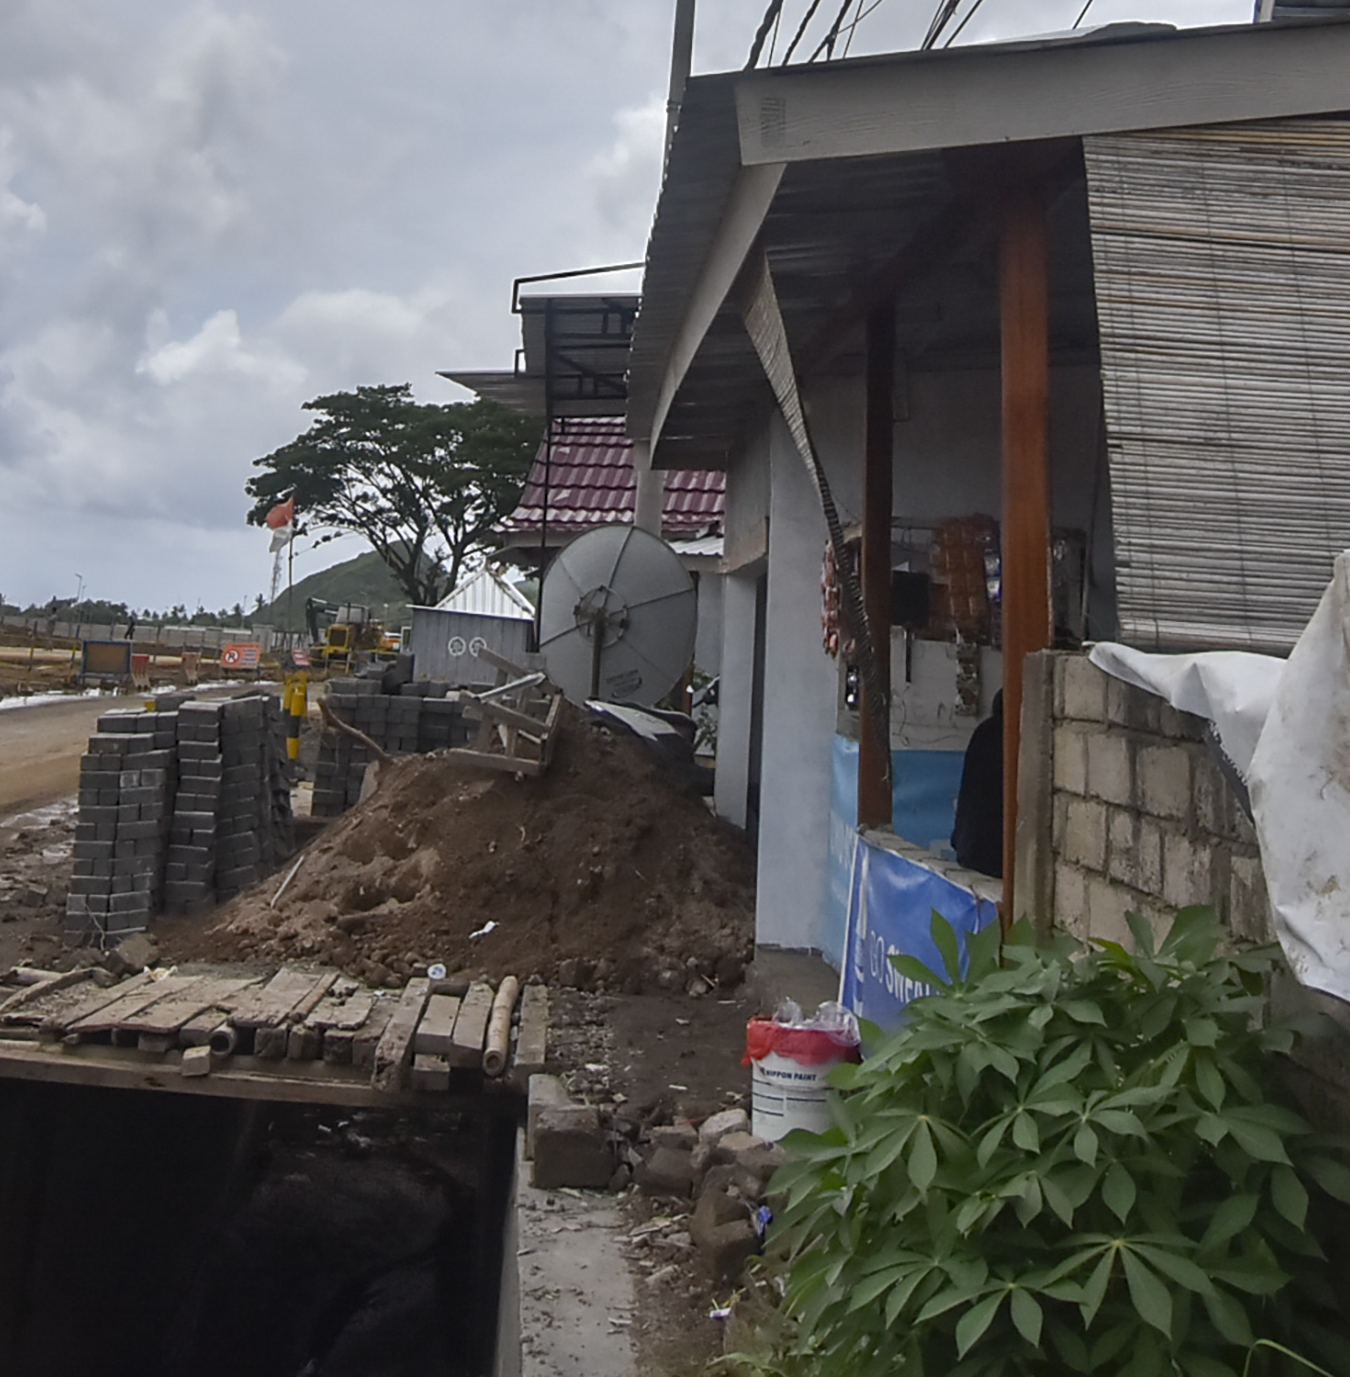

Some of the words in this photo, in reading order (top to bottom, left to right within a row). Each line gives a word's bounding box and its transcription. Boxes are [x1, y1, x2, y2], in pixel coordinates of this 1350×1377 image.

[885, 943, 931, 1004] SWE
[766, 1069, 793, 1080] NIPPON
[793, 1072, 817, 1082] PAINT
